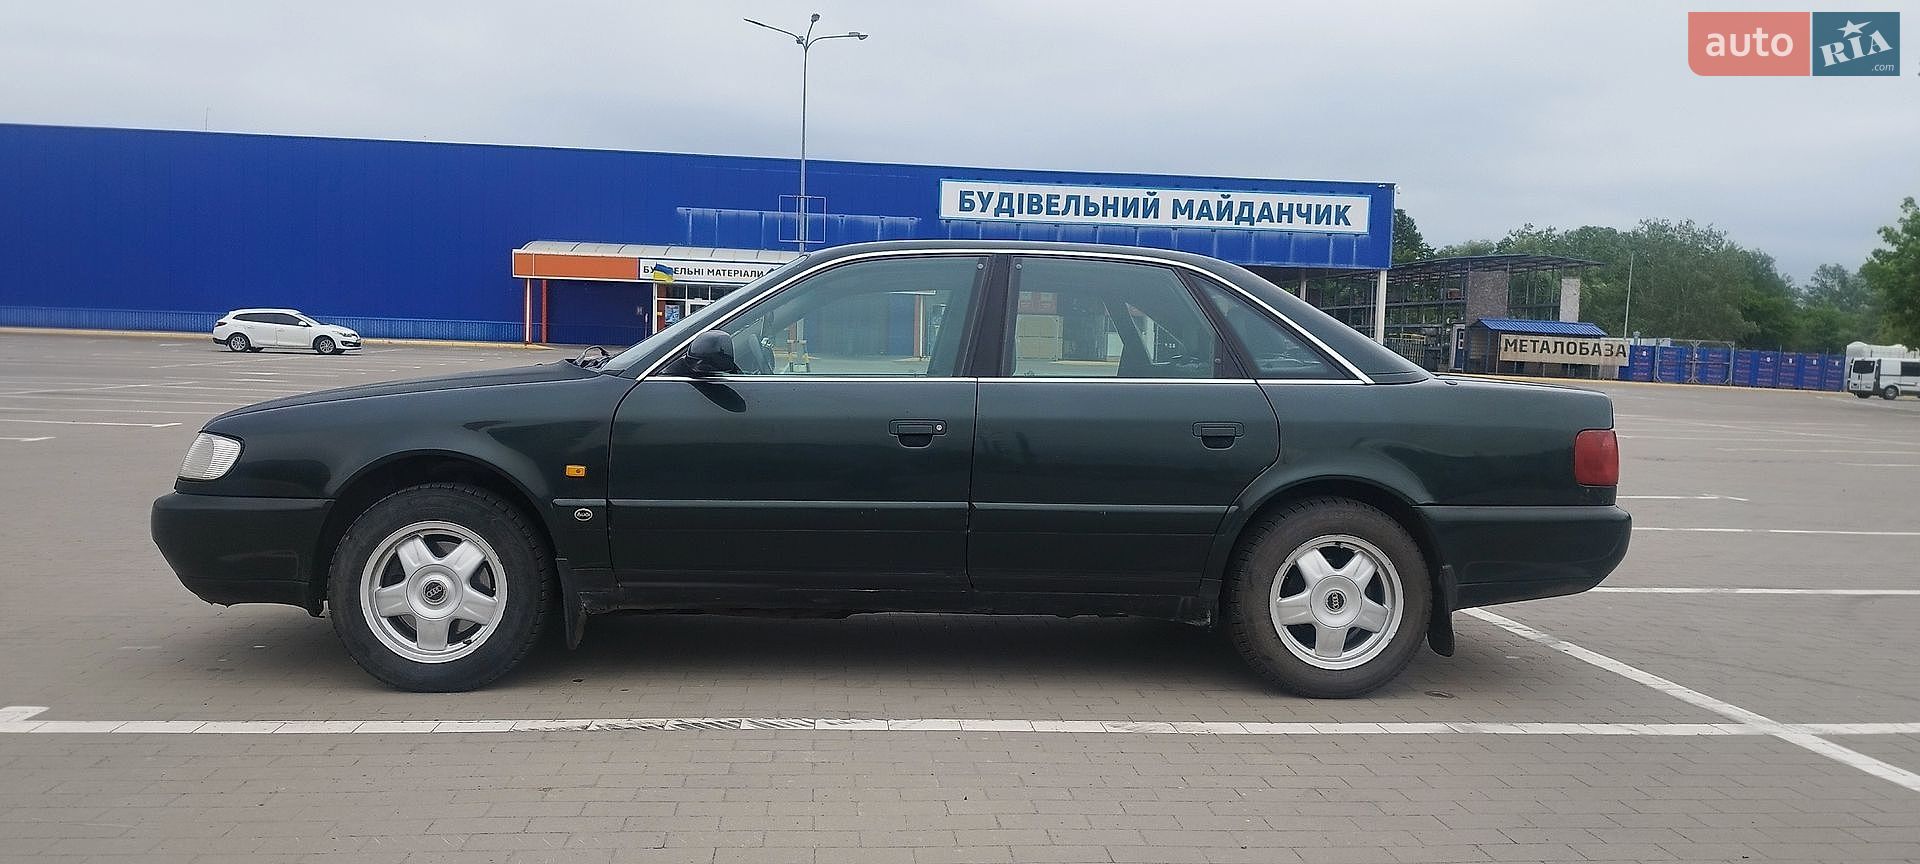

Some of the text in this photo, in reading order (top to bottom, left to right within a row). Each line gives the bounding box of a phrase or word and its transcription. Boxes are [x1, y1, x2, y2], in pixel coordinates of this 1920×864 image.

[958, 189, 1352, 227] БУДІВЕЛЬНИЙ МАЙДАНЧИК
[643, 265, 764, 278] БУЕЛЬНІ МАТЕРІАЛИ
[1503, 338, 1627, 358] МЕТАЛОБАЗА
